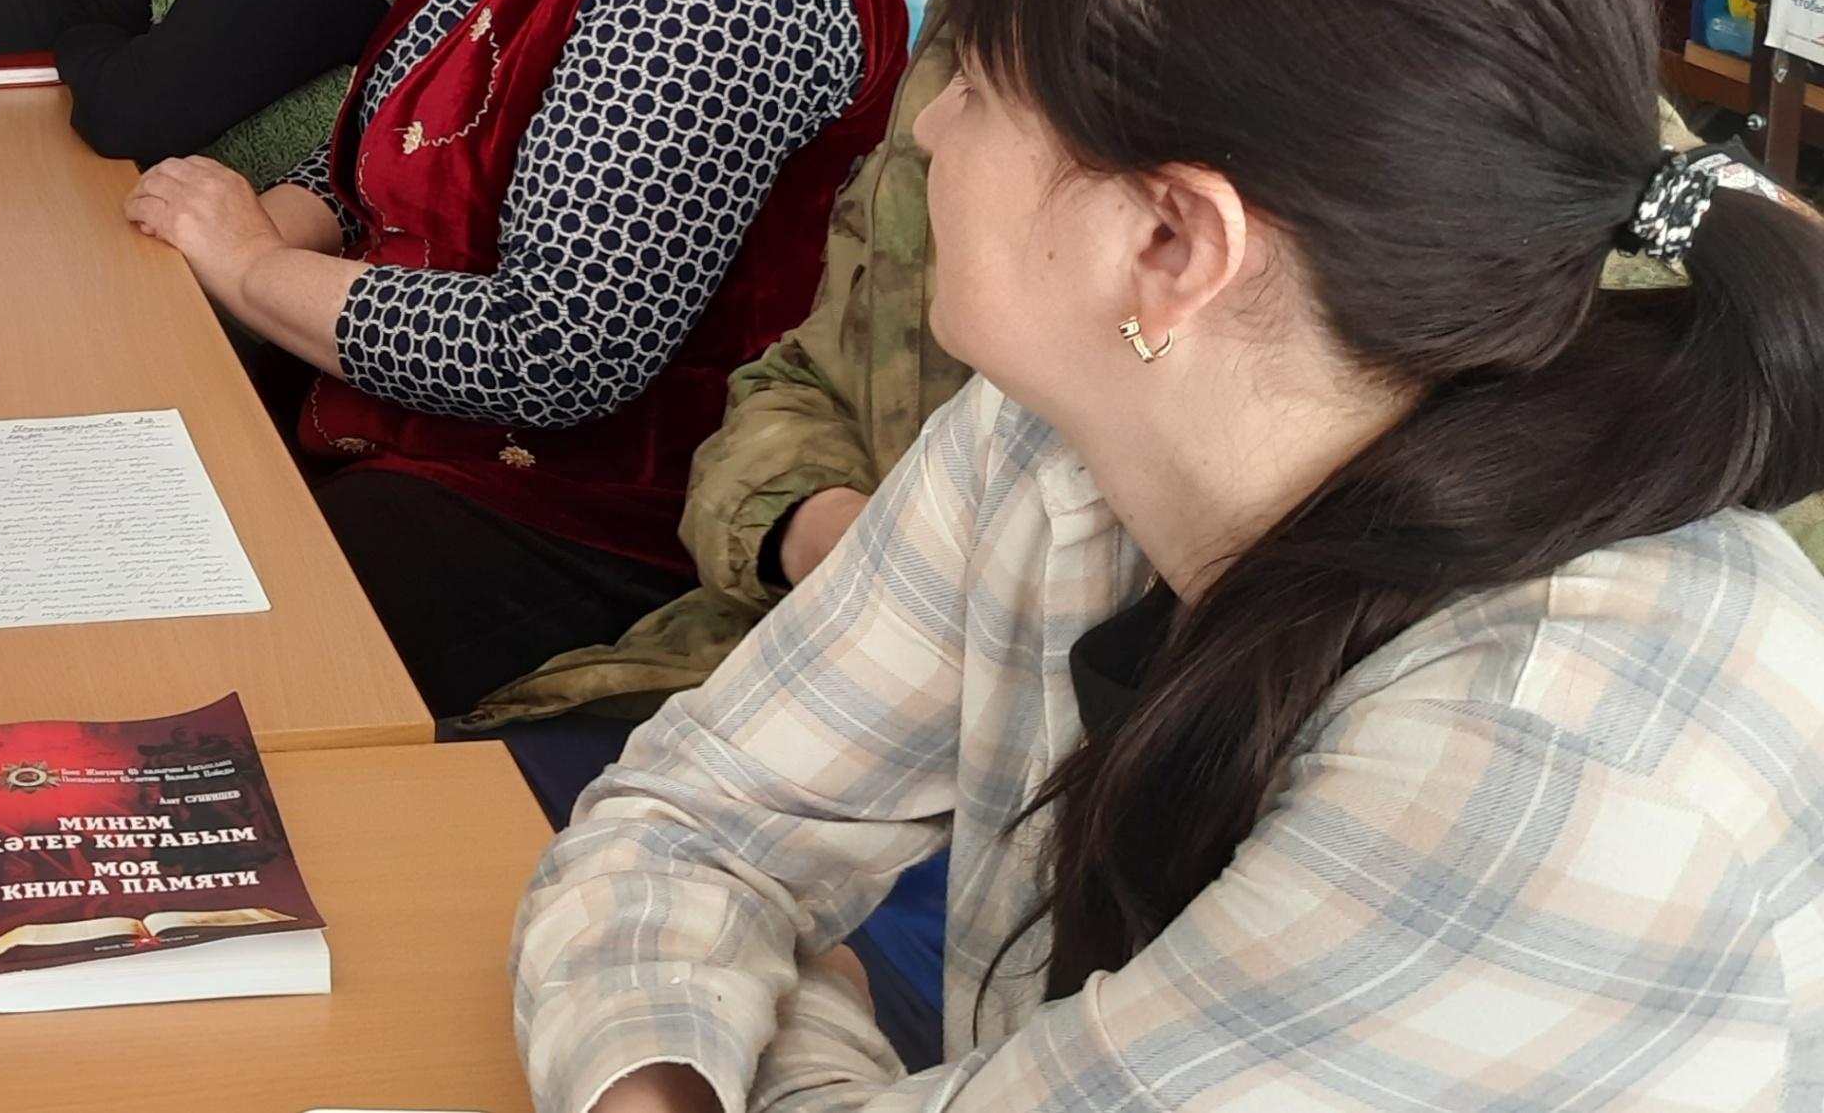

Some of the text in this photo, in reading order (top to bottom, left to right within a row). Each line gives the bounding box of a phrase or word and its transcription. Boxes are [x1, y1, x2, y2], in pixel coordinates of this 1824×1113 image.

[57, 816, 174, 832] МИНЕМ
[95, 827, 258, 849] КИТАБЫМ
[91, 861, 161, 877] МОЯ
[0, 871, 260, 901] КНИГА ПАМЯТИ
